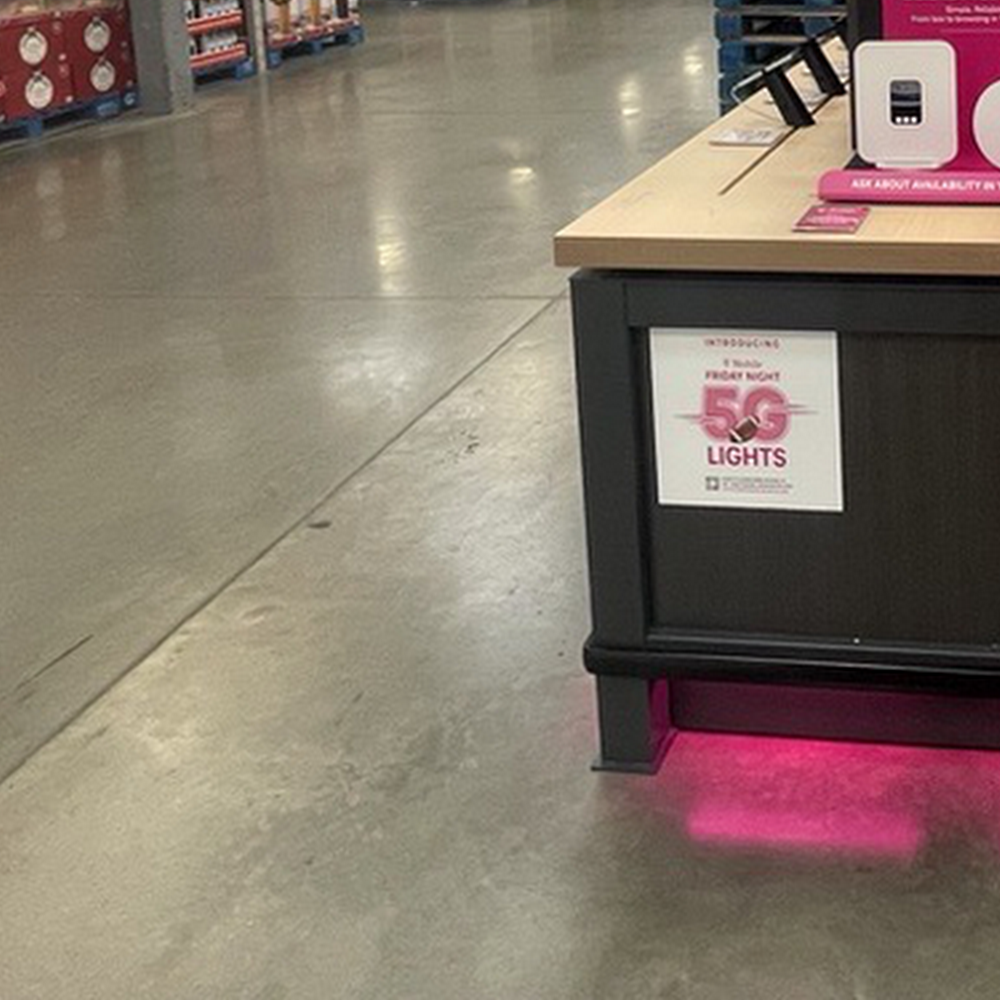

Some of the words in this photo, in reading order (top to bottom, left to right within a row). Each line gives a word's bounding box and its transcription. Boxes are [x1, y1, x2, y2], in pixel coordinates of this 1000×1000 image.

[851, 178, 872, 189] ASK
[874, 179, 911, 190] ABOUT
[912, 179, 982, 191] AVAILABILITY
[983, 180, 995, 191] IN
[703, 338, 780, 350] INTRODUCING
[705, 369, 743, 381] FRIDAY
[745, 370, 780, 382] NIGHT
[702, 385, 789, 442] 5G
[707, 446, 787, 468] LIGHTS
